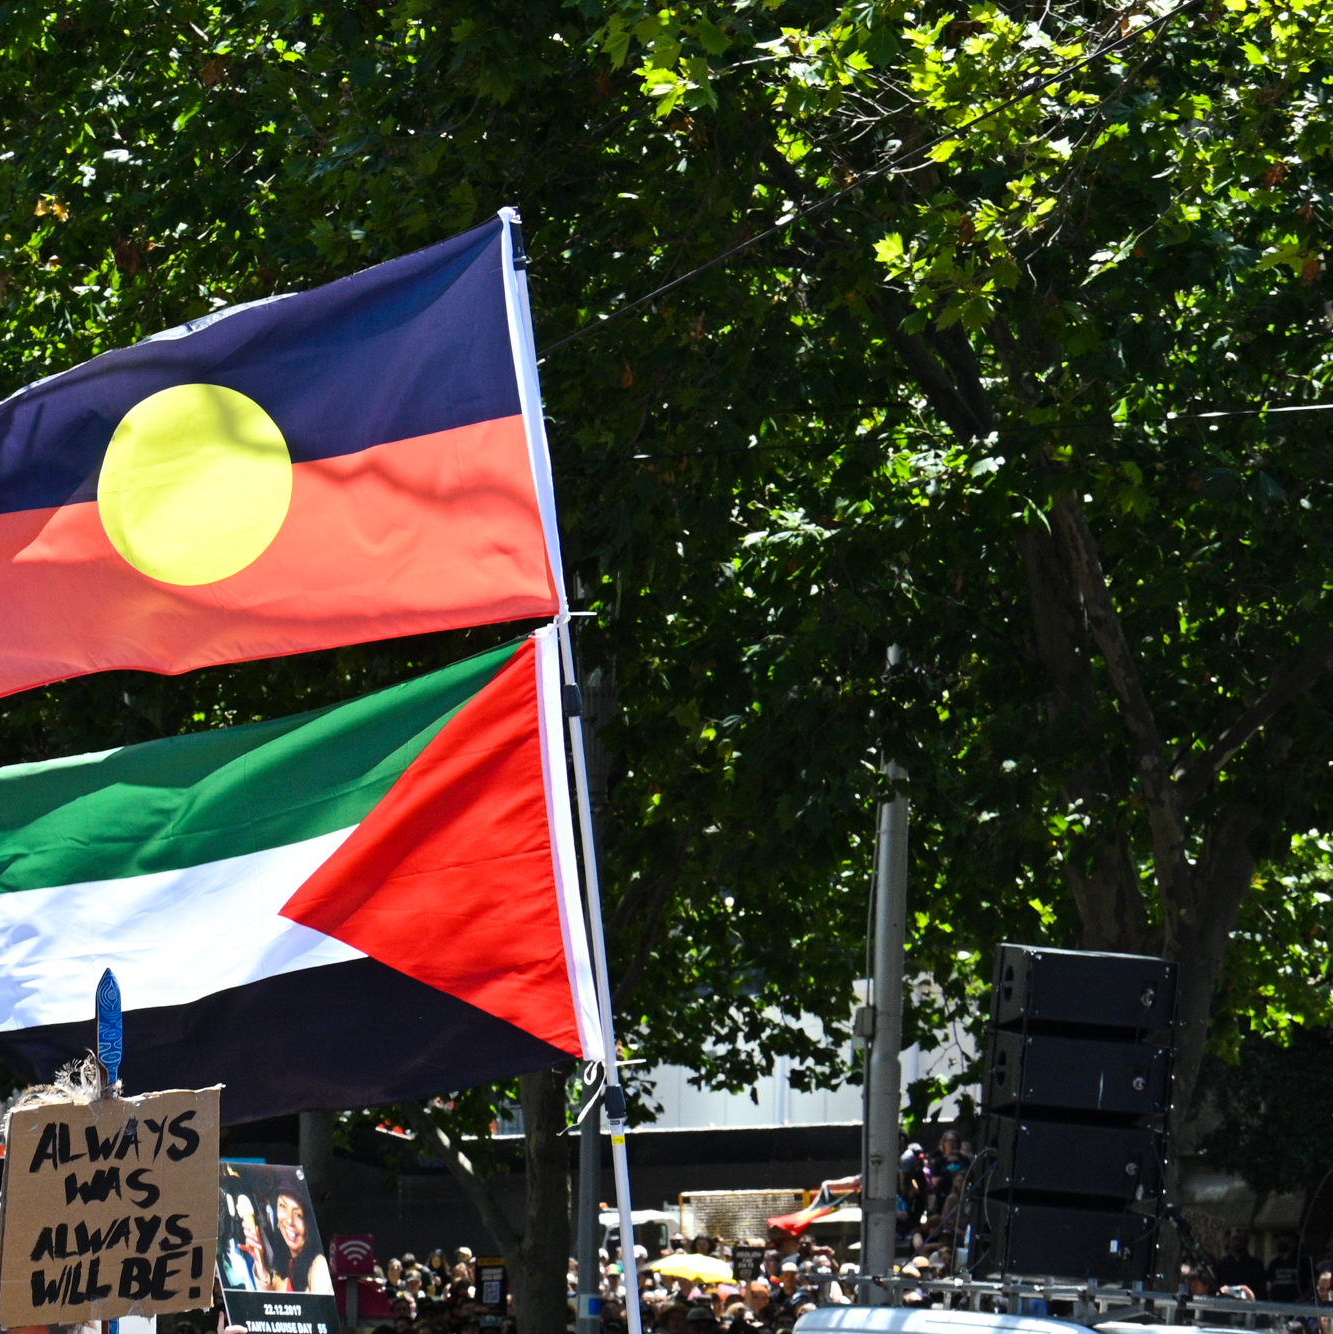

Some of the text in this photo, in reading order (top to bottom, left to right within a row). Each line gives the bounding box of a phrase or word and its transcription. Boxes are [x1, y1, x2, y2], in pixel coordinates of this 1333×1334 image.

[29, 1110, 200, 1173] ALWAYS
[64, 1166, 161, 1209] WAS
[30, 1214, 193, 1262] ALWAYS
[30, 1245, 203, 1311] WILL BE!
[246, 1321, 328, 1334] TANYA LOUISE DAY 55
[263, 1304, 302, 1316] 22.12.2017
